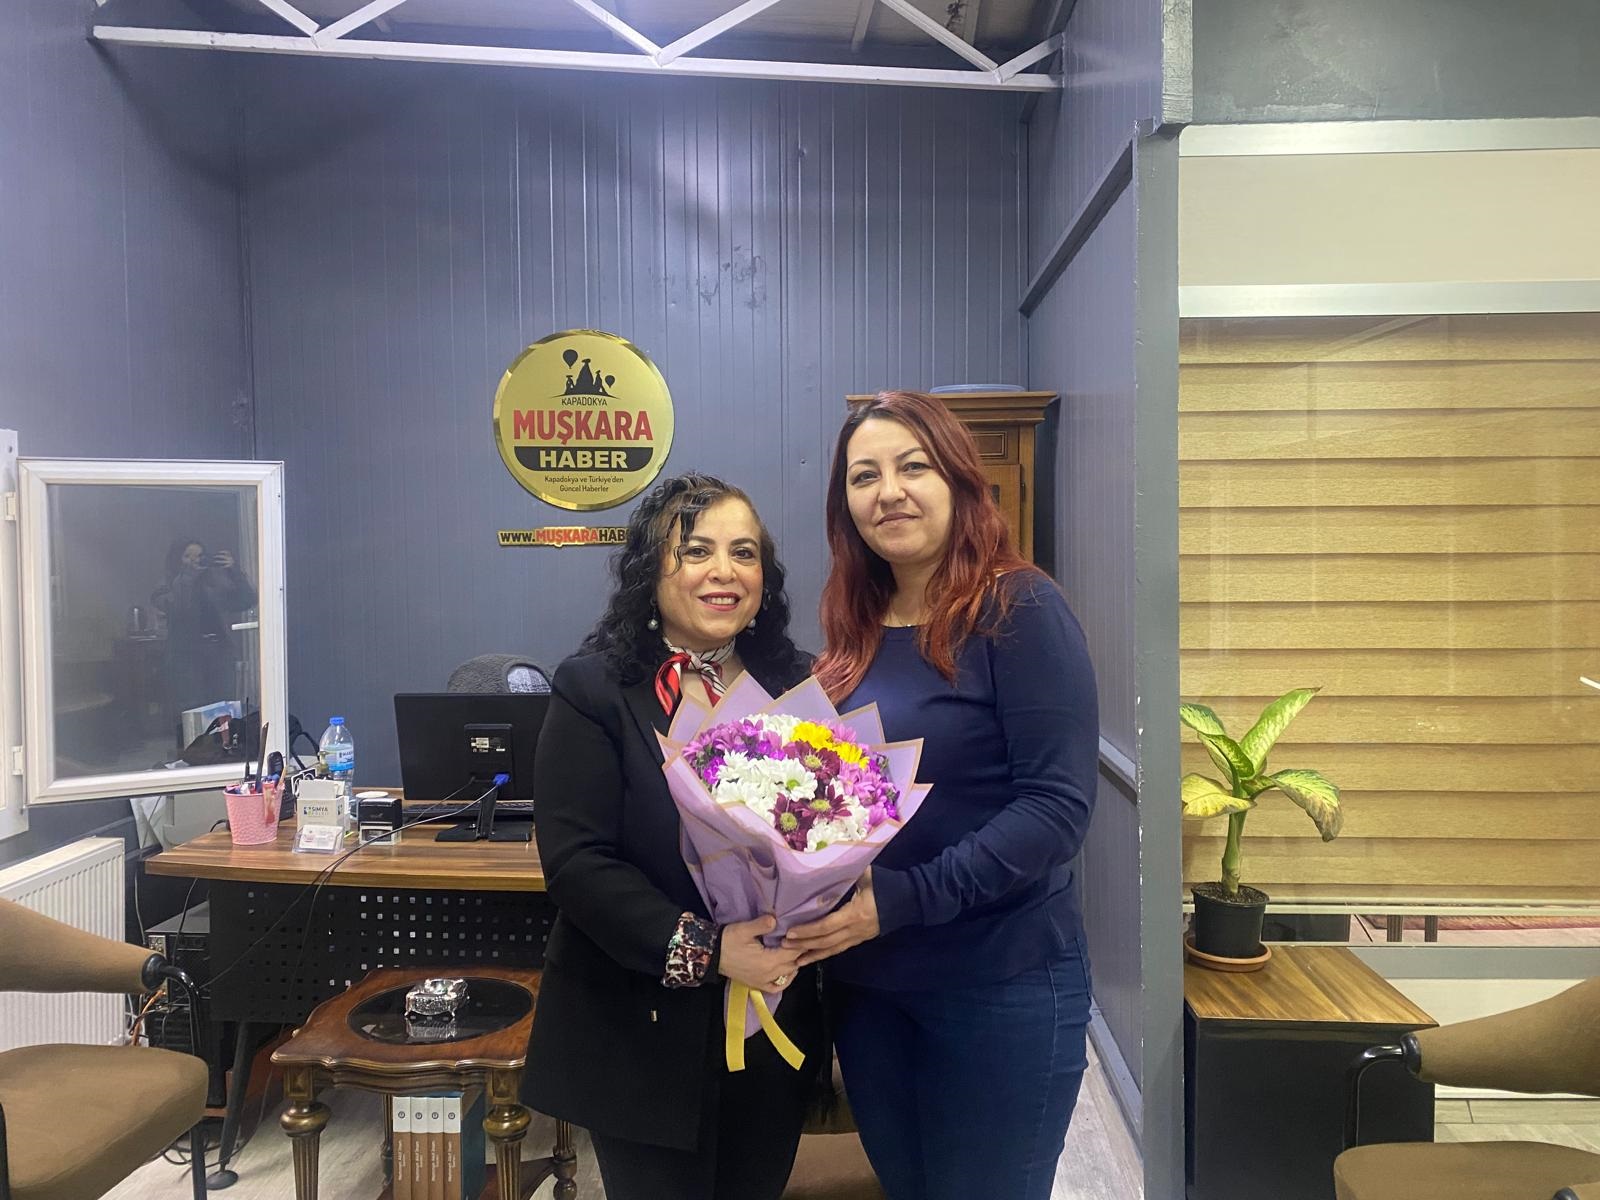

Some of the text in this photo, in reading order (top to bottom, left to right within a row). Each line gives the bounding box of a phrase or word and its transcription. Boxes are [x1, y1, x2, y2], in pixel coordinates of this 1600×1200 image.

[561, 397, 608, 406] KAPADOKYA
[513, 410, 653, 445] MUŞKARA
[539, 450, 628, 469] HABER
[544, 476, 579, 484] Kapadokya
[589, 476, 624, 484] Türkiye'den
[500, 528, 628, 544] www.MUŞKARAHAB
